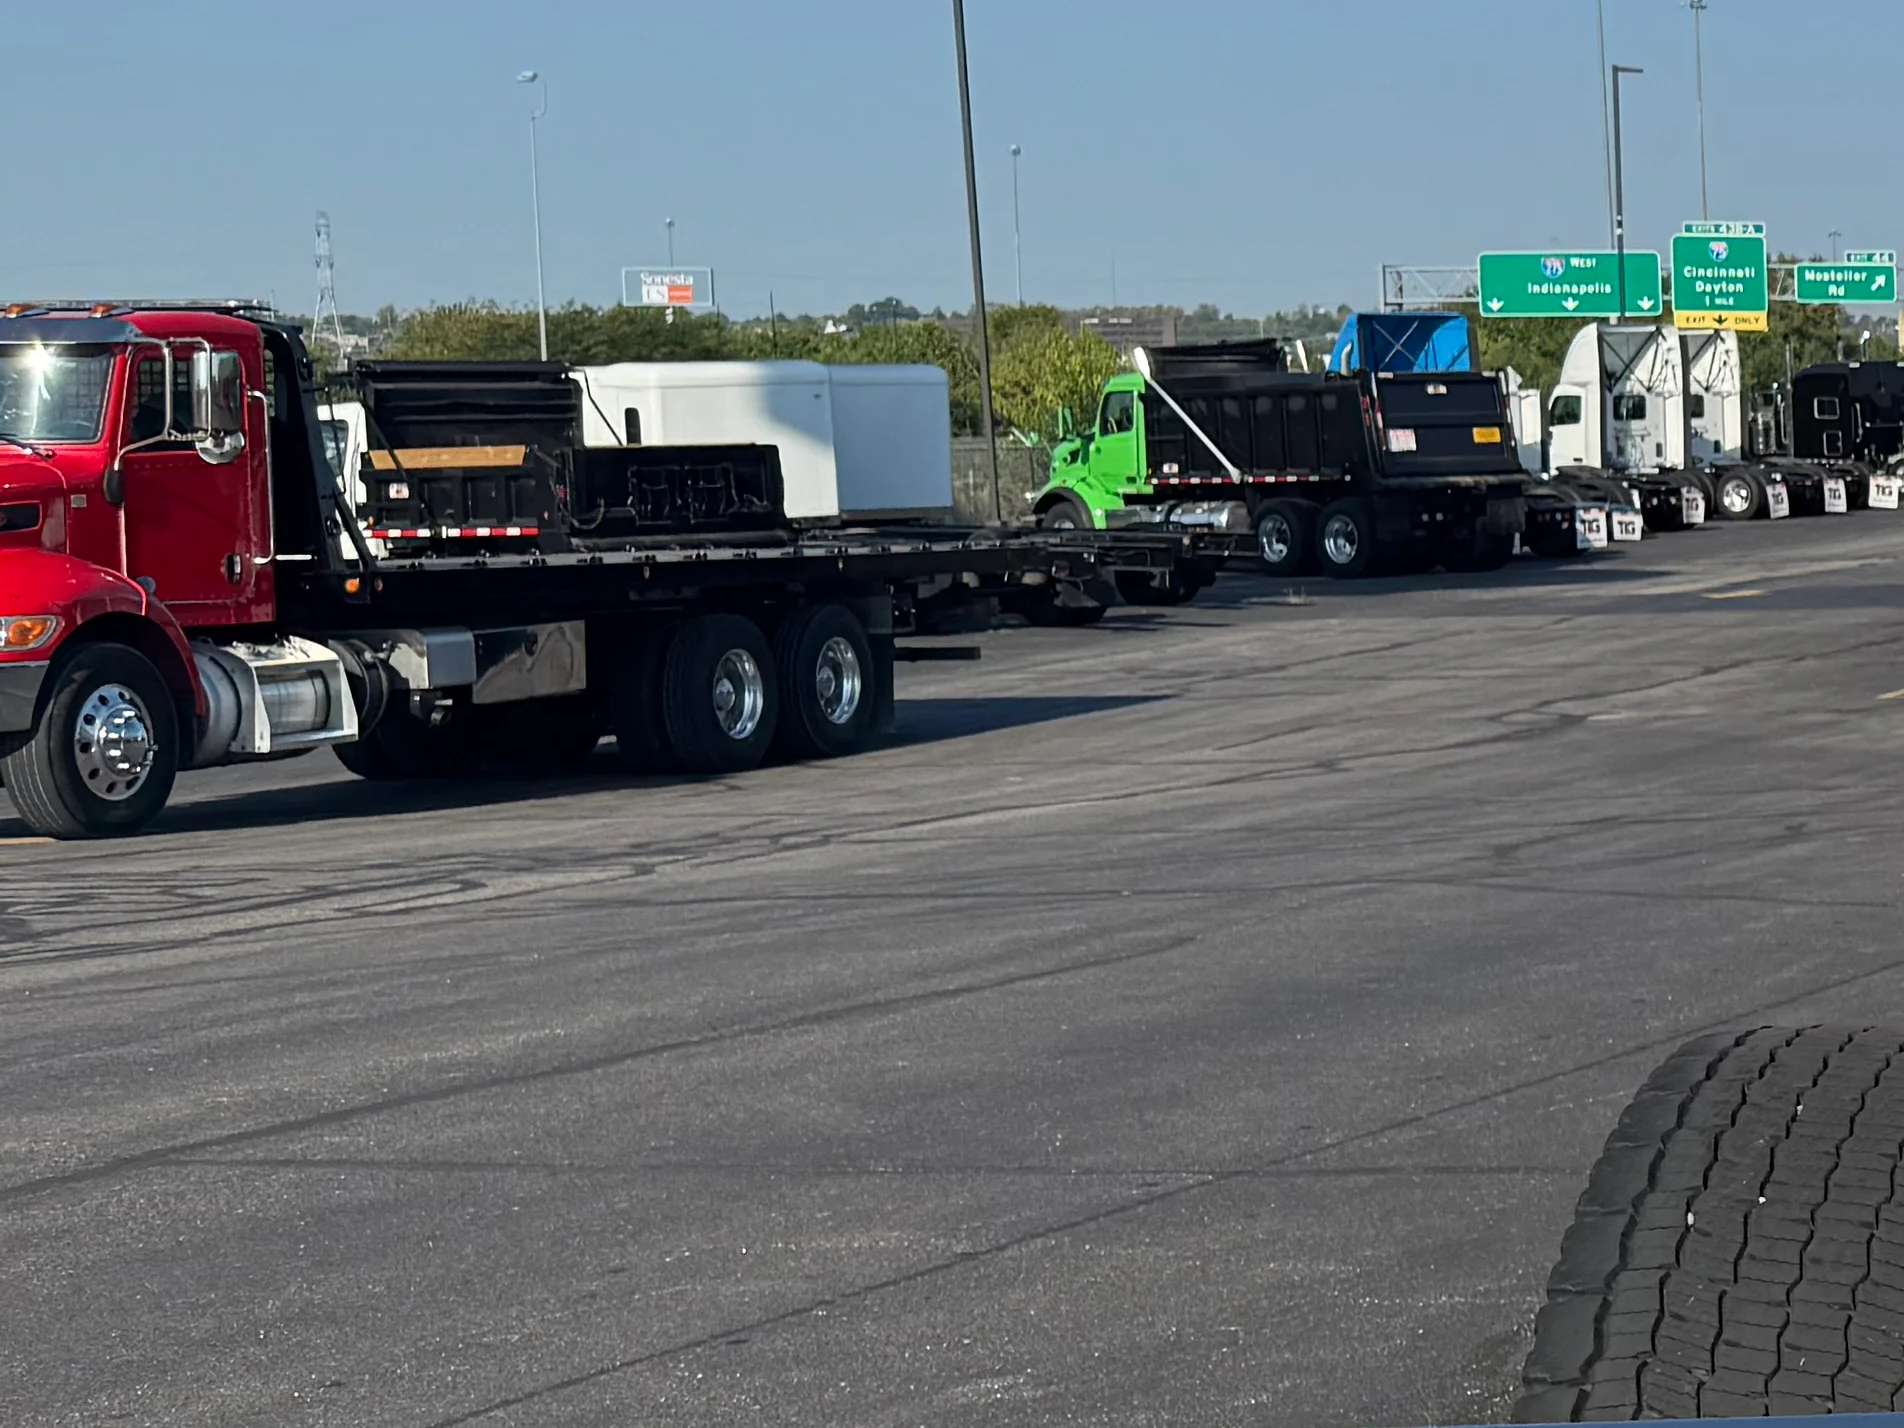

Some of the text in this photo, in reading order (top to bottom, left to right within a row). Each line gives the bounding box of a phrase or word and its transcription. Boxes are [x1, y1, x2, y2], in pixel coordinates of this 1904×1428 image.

[1570, 256, 1596, 268] WEST
[1683, 265, 1755, 278] Cincinnati
[1805, 269, 1867, 282] Mosteller
[1528, 282, 1612, 295] Indianapolis
[1695, 280, 1744, 295] Dayton
[1828, 284, 1845, 297] Rd
[1735, 316, 1761, 325] ONLY
